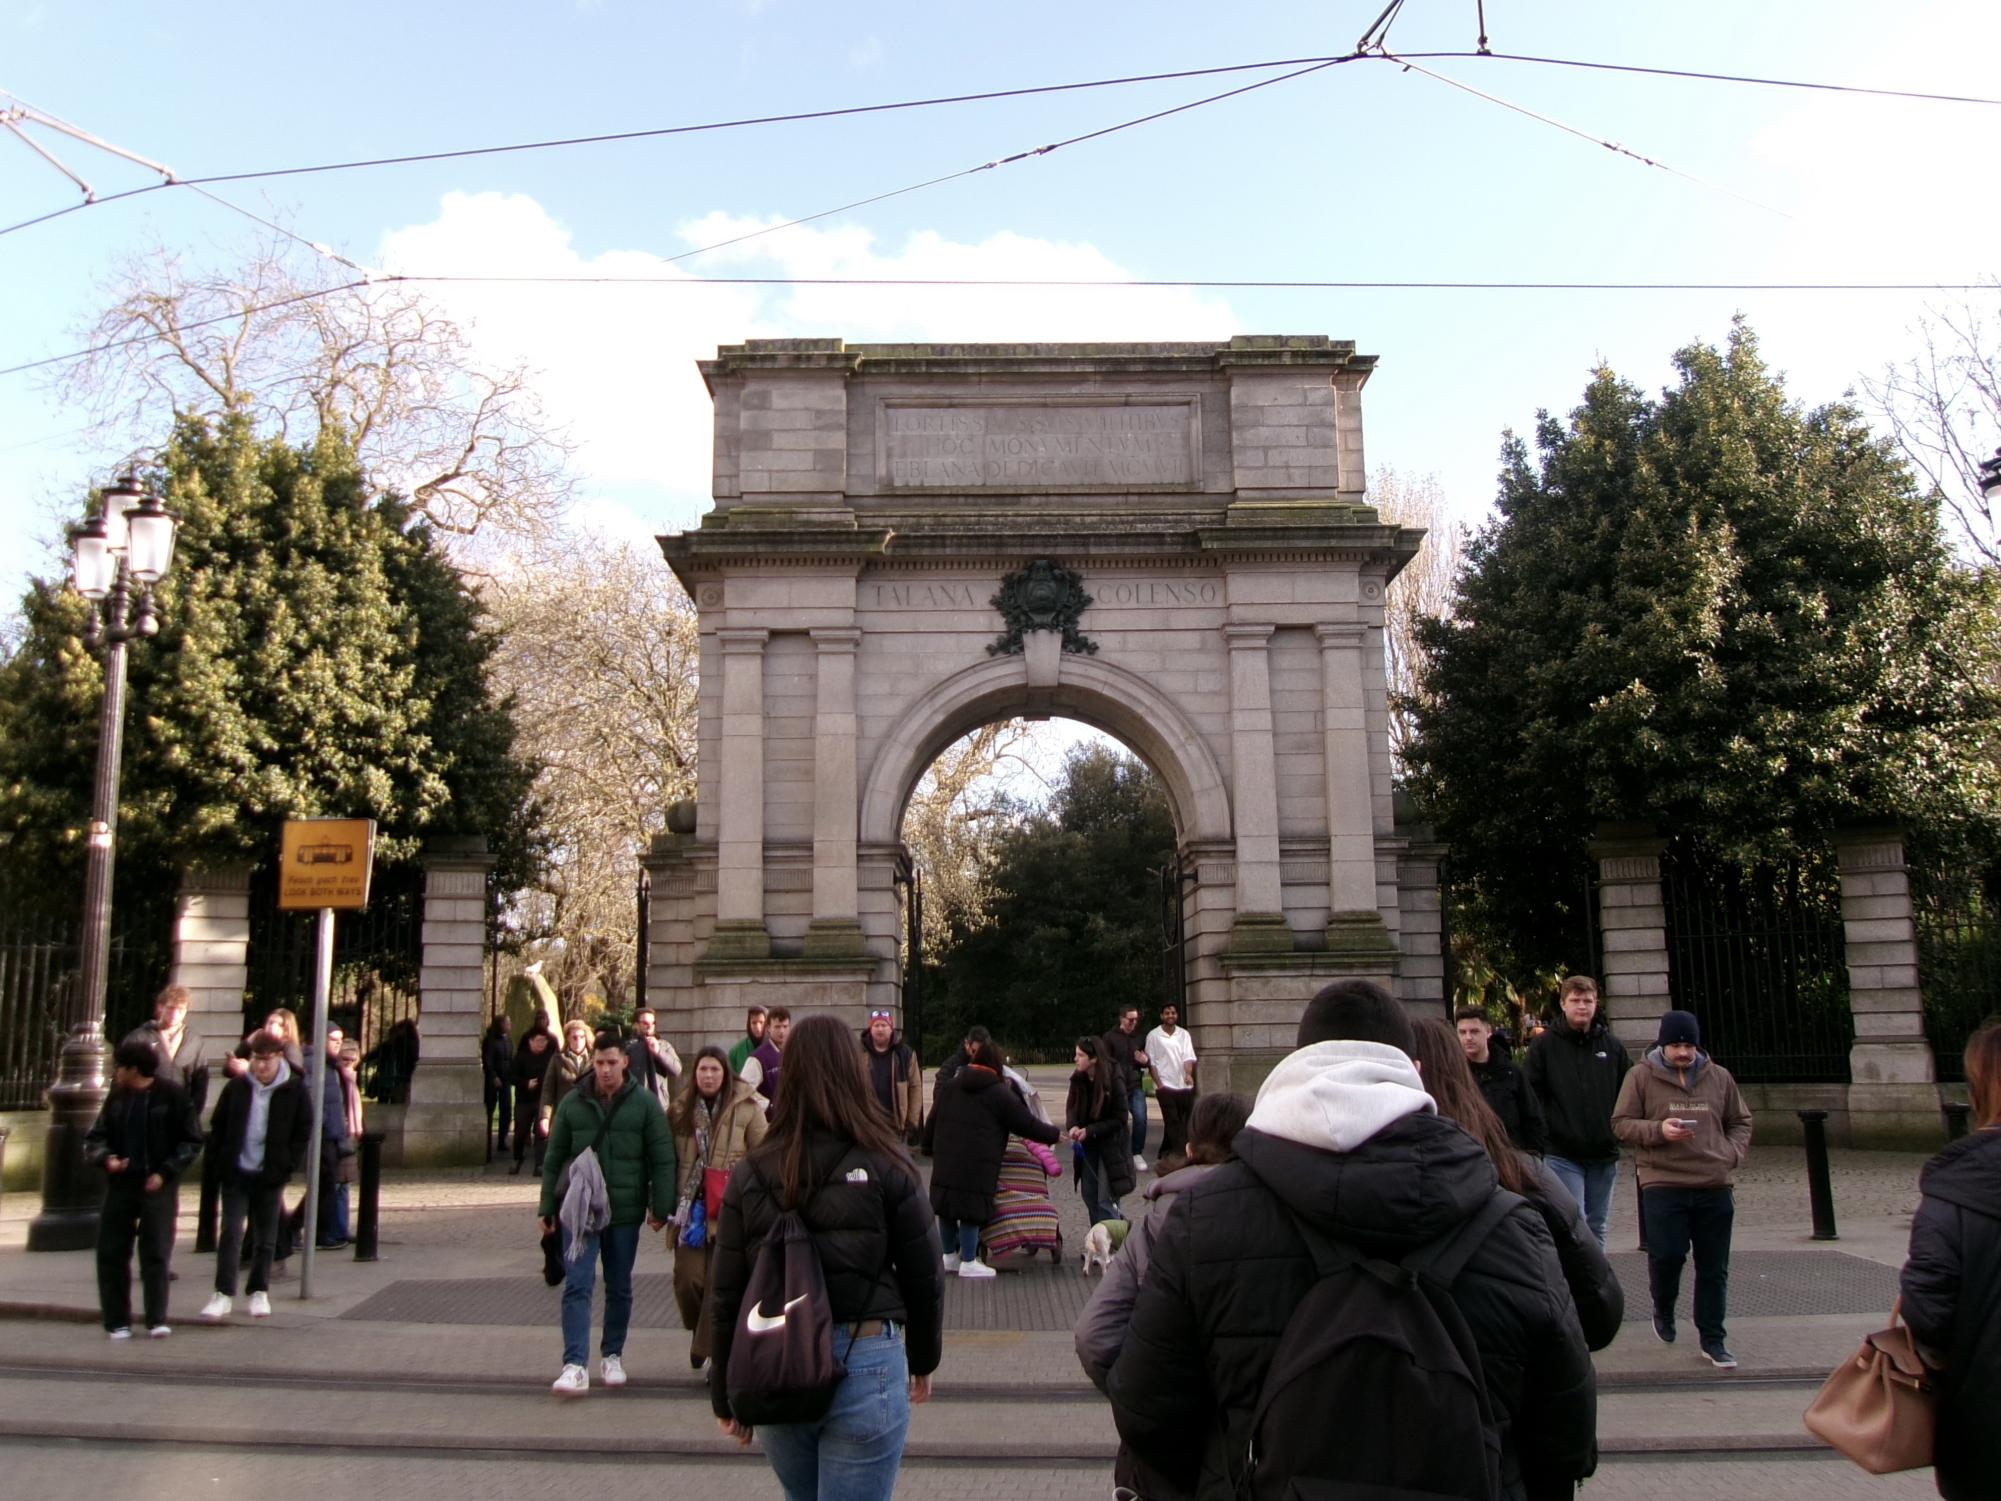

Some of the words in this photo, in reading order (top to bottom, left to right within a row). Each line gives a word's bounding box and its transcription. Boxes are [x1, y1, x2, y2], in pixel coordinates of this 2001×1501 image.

[926, 437, 975, 456] HOC
[894, 460, 982, 479] EBLANA
[872, 584, 976, 606] TALANA
[1096, 582, 1217, 605] COLENSO
